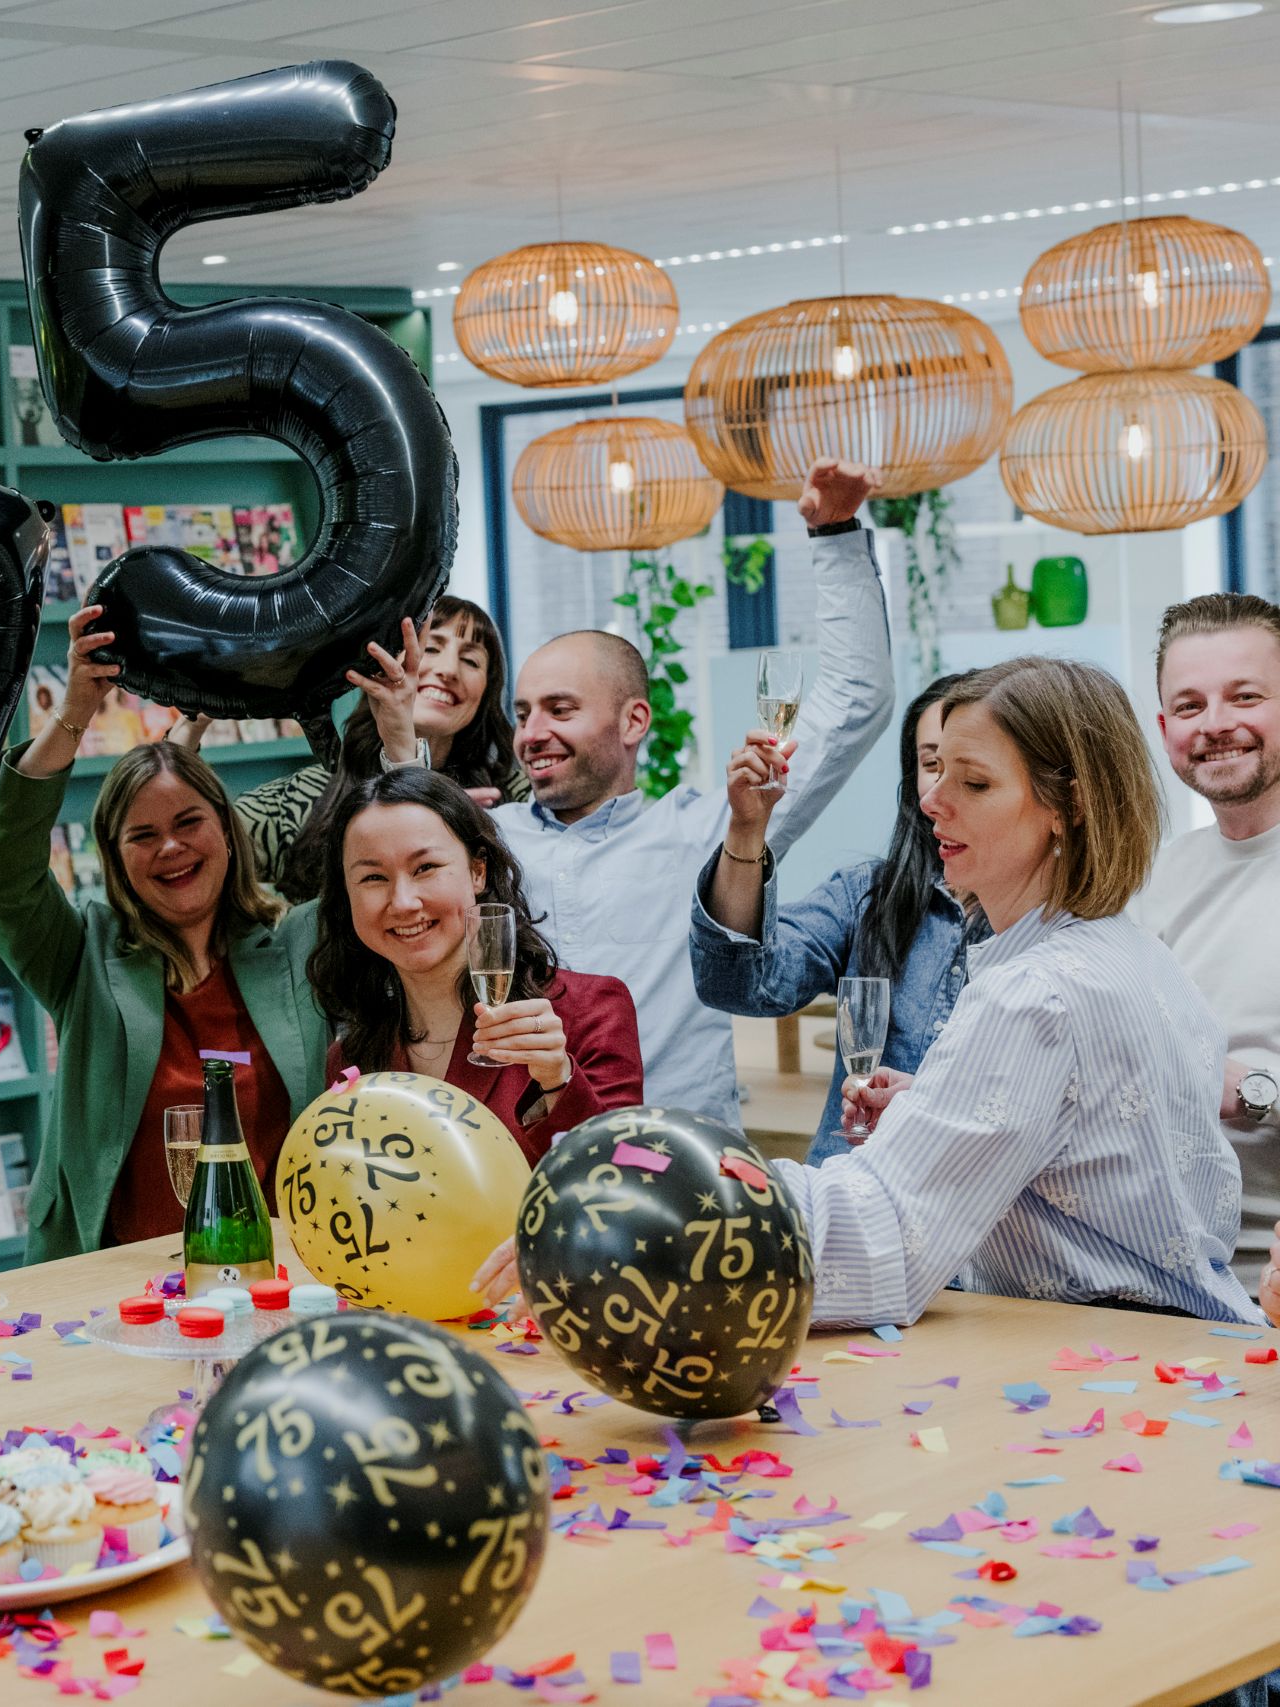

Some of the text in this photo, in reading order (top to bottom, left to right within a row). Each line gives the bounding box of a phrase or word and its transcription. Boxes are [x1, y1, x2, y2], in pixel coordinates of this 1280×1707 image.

[313, 1097, 358, 1148] 75
[426, 1088, 481, 1130] 75
[283, 1162, 317, 1225] 75
[361, 1133, 421, 1191] 75
[573, 1163, 638, 1232] 75
[329, 1202, 391, 1264] 75
[684, 1216, 755, 1282] 75
[532, 1280, 591, 1352] 75
[603, 1265, 680, 1347] 75
[736, 1287, 797, 1350] 75
[266, 1321, 348, 1376] 75
[642, 1348, 715, 1400] 75
[236, 1397, 316, 1483] 75
[344, 1416, 439, 1507] 75
[212, 1538, 302, 1629] 75
[461, 1512, 532, 1595] 75
[324, 1566, 427, 1656] 75
